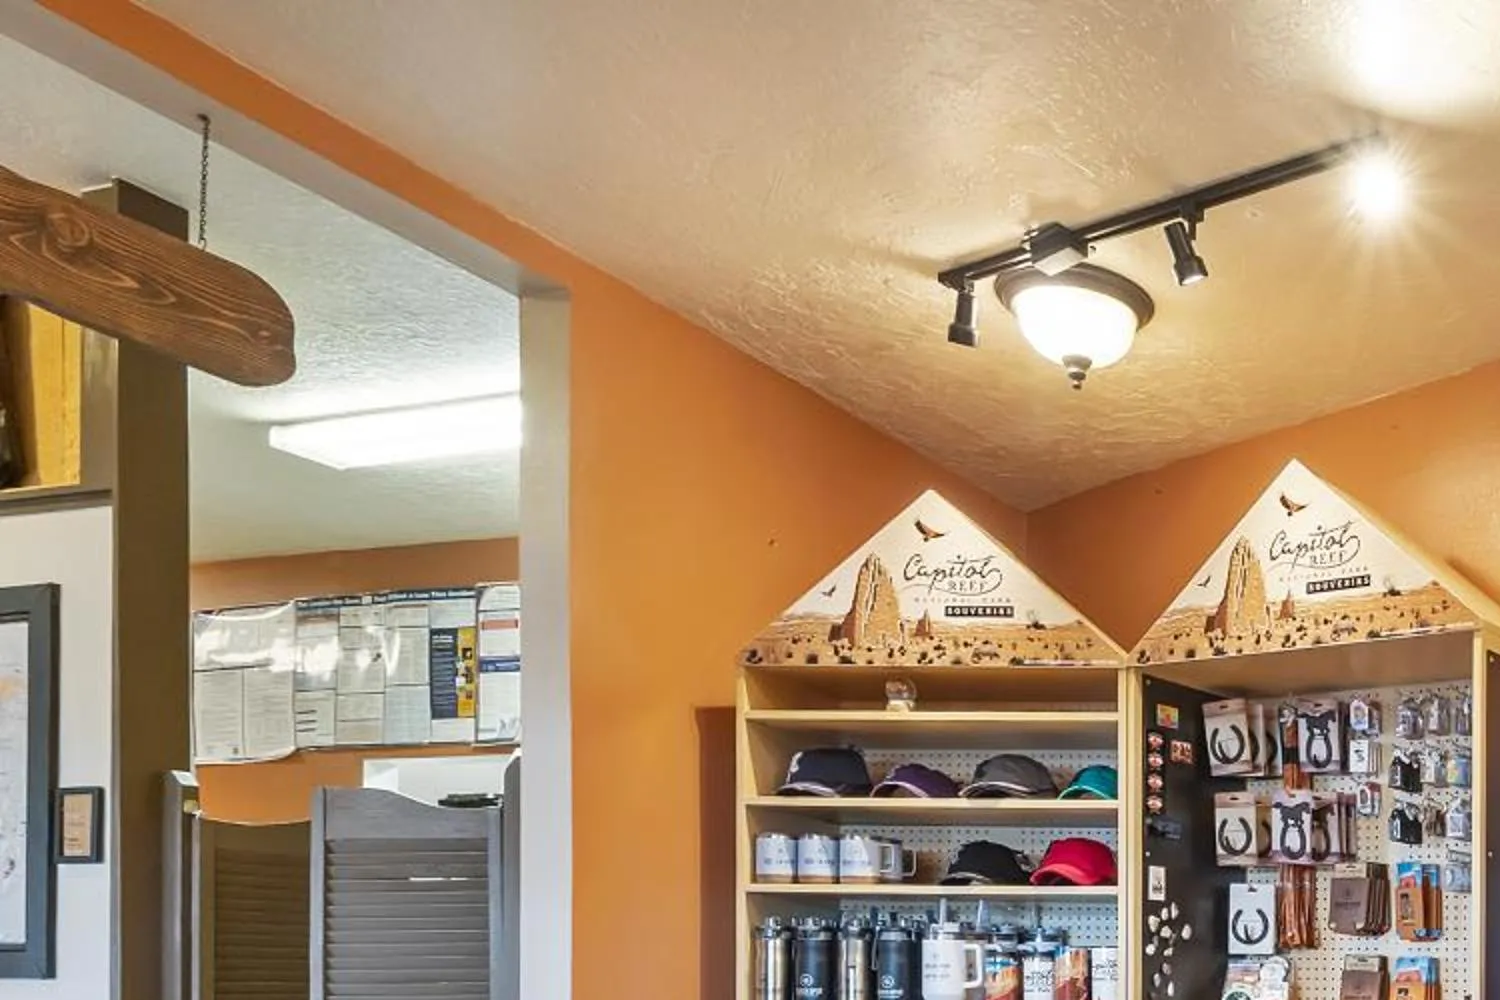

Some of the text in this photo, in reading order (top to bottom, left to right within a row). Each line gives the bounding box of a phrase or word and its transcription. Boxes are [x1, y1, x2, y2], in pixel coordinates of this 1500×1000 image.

[1268, 521, 1360, 573] Capitol
[1309, 550, 1347, 565] REEF
[902, 553, 1002, 595] Capitol
[947, 580, 988, 592] REEF
[1308, 575, 1369, 593] SOUVENIRS
[946, 607, 1013, 616] SOUVENIRS
